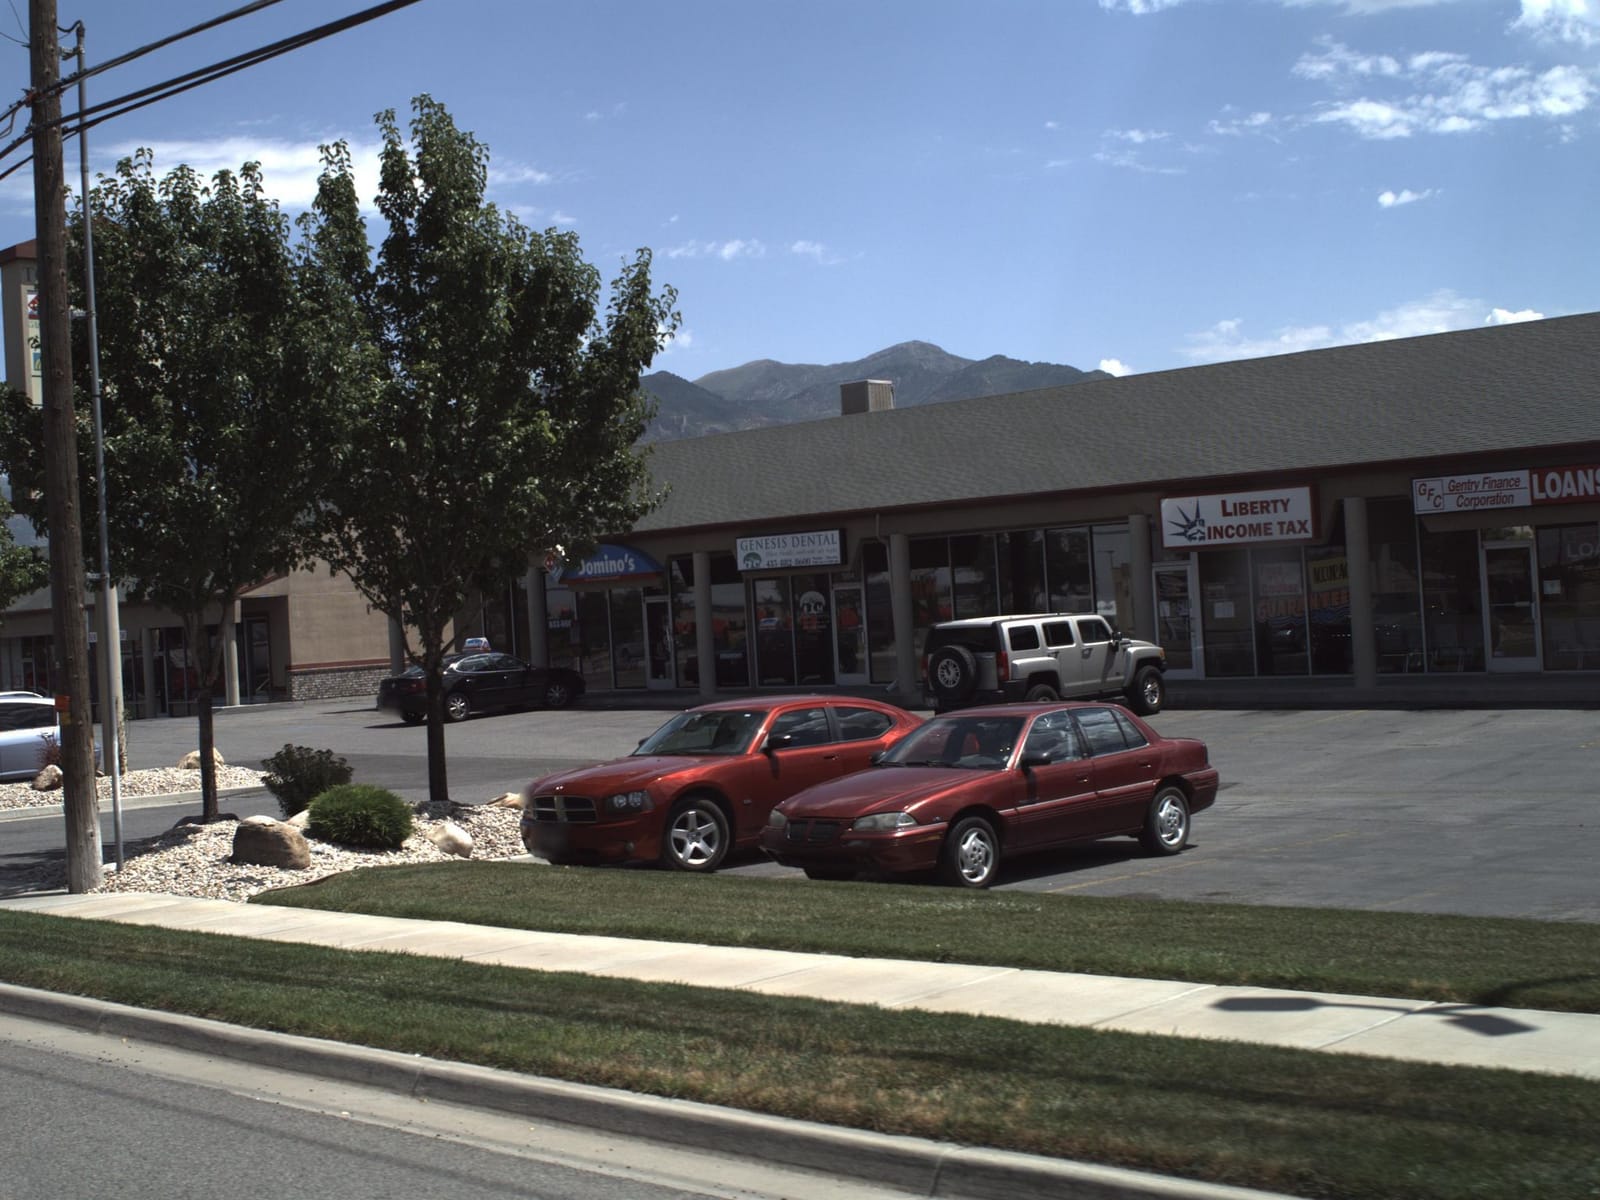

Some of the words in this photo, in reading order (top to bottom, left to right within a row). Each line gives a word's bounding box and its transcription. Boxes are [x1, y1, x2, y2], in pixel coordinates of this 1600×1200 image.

[1447, 478, 1480, 493] Gentry
[1481, 475, 1521, 491] Finance
[1220, 498, 1290, 518] LIBERTY
[1456, 492, 1514, 510] Corporation
[1207, 521, 1273, 540] INCOME
[1276, 519, 1310, 535] TAX
[740, 537, 787, 552] GENESIS
[791, 533, 837, 549] DENTAL
